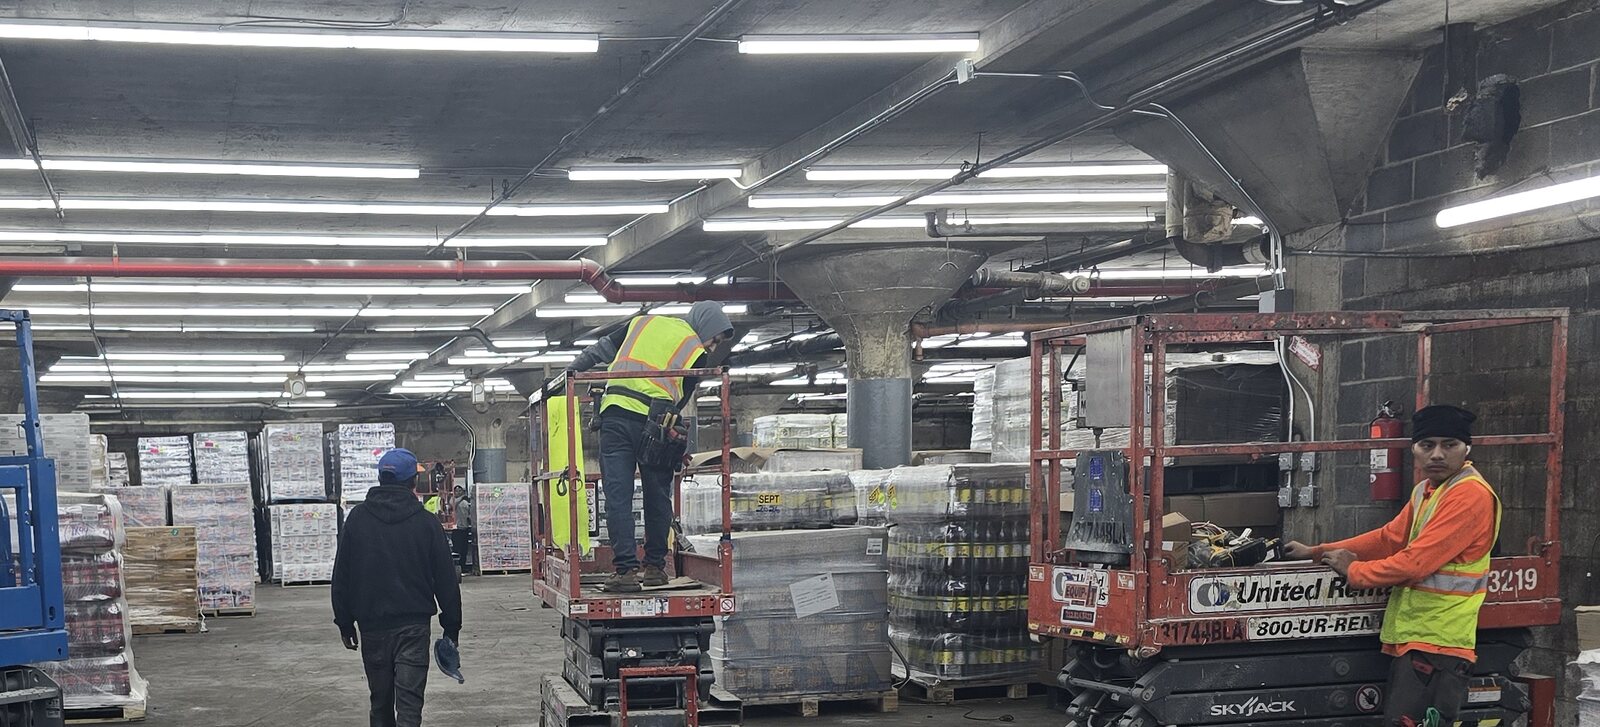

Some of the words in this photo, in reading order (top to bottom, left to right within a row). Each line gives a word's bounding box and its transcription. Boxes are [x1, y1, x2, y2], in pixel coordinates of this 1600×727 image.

[758, 494, 780, 504] SEPT
[1237, 578, 1322, 604] United
[1328, 576, 1392, 599] Renta
[1488, 567, 1538, 593] 3219
[1256, 615, 1382, 636] 800-UR-REN
[1210, 696, 1296, 717] SKYJACK
